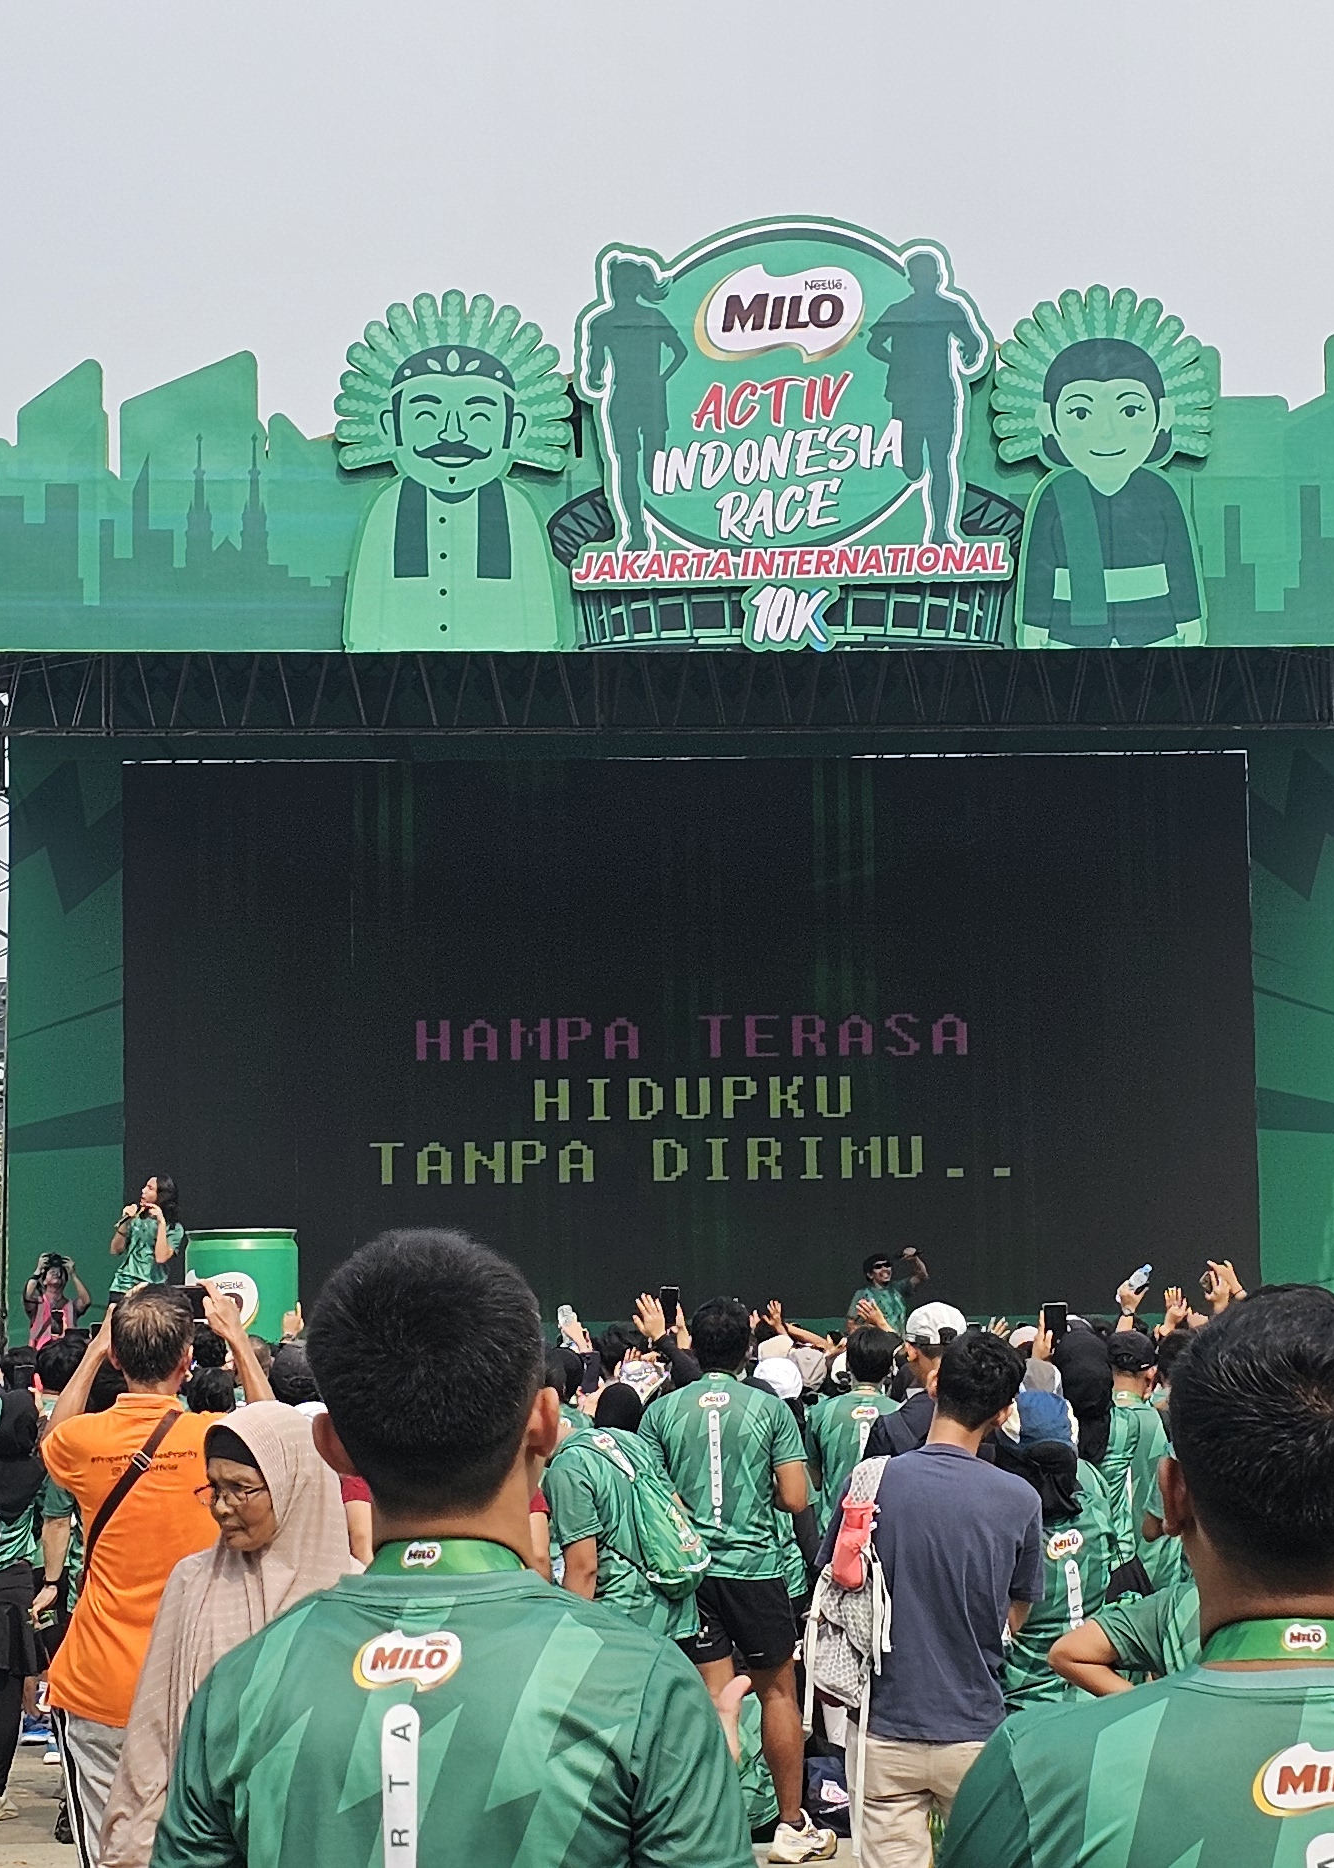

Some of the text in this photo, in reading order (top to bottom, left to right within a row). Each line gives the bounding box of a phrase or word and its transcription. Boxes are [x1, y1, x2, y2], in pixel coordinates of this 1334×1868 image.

[722, 293, 844, 333] MILO
[692, 371, 853, 432] ACTIV
[651, 418, 904, 496] INDONESIA
[715, 478, 840, 545] RACE
[573, 542, 1008, 583] JAKARTA INTERNATIONAL
[751, 586, 829, 645] 10K
[415, 1014, 969, 1061] HAMPA TERASA
[534, 1076, 852, 1122] HIDUPKU
[369, 1140, 594, 1184] TANPA
[370, 1646, 448, 1671] MILO
